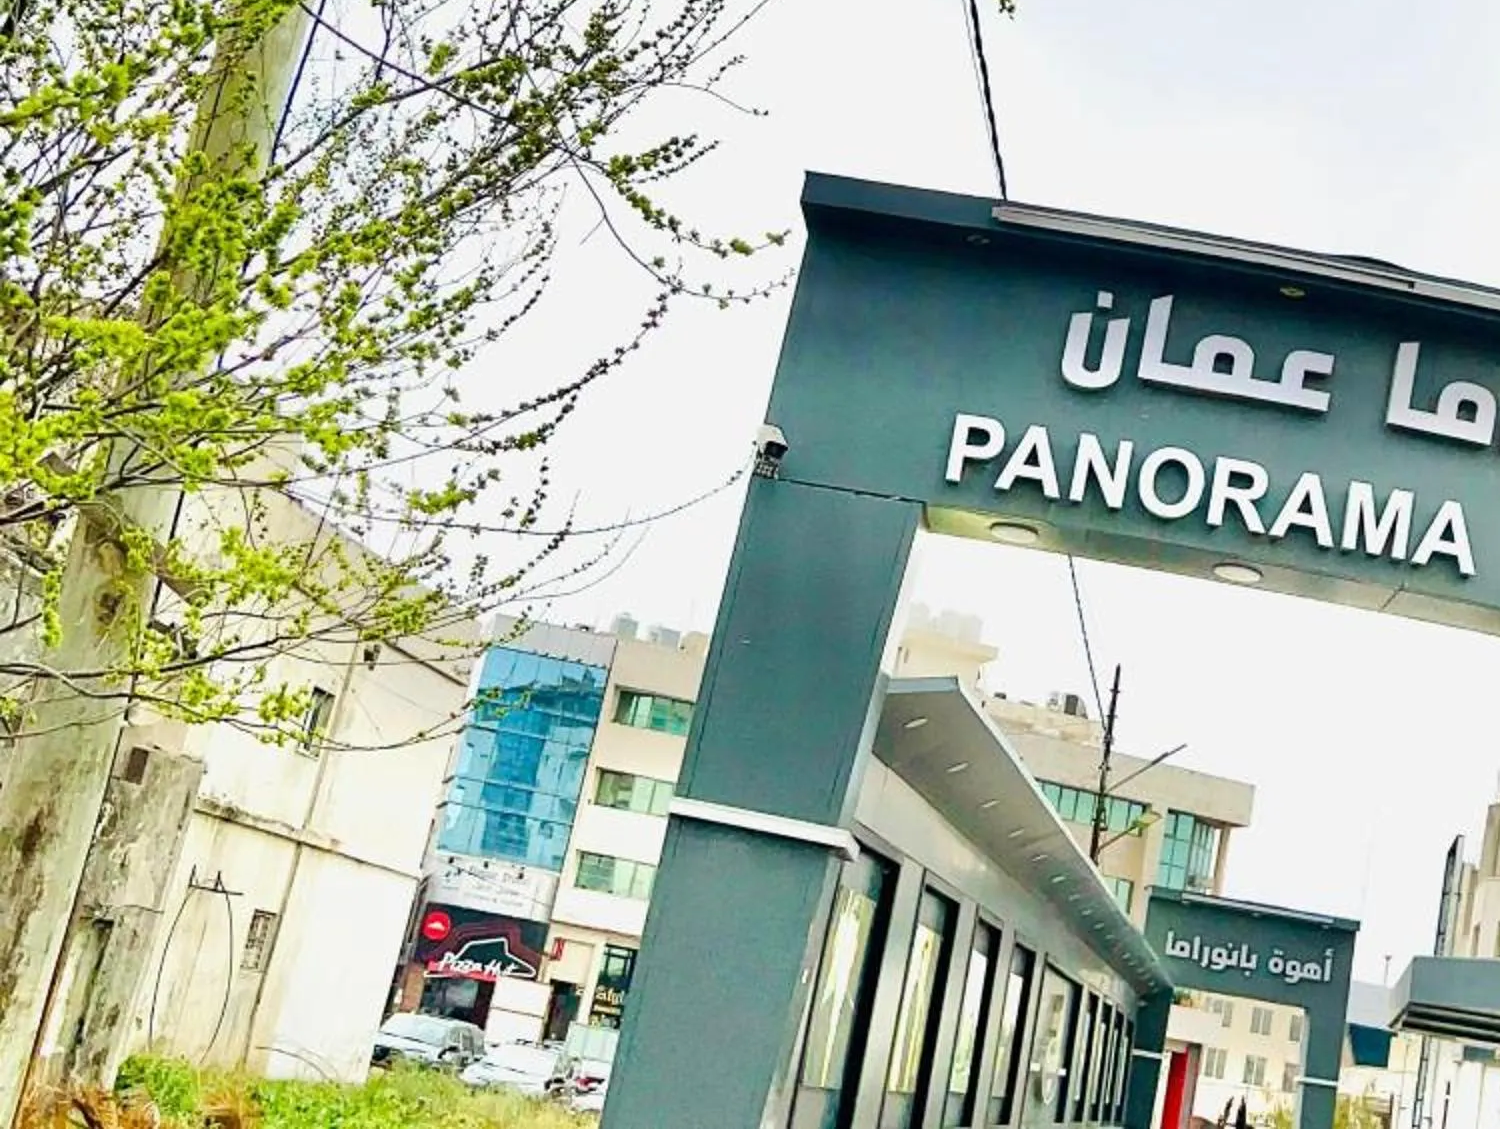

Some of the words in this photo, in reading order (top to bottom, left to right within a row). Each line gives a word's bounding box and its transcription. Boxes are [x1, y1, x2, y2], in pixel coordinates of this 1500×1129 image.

[1059, 290, 1335, 412] عمان
[944, 413, 1476, 577] PANORAMA
[1165, 930, 1257, 976] بانوراما
[1268, 948, 1335, 983] أهوة
